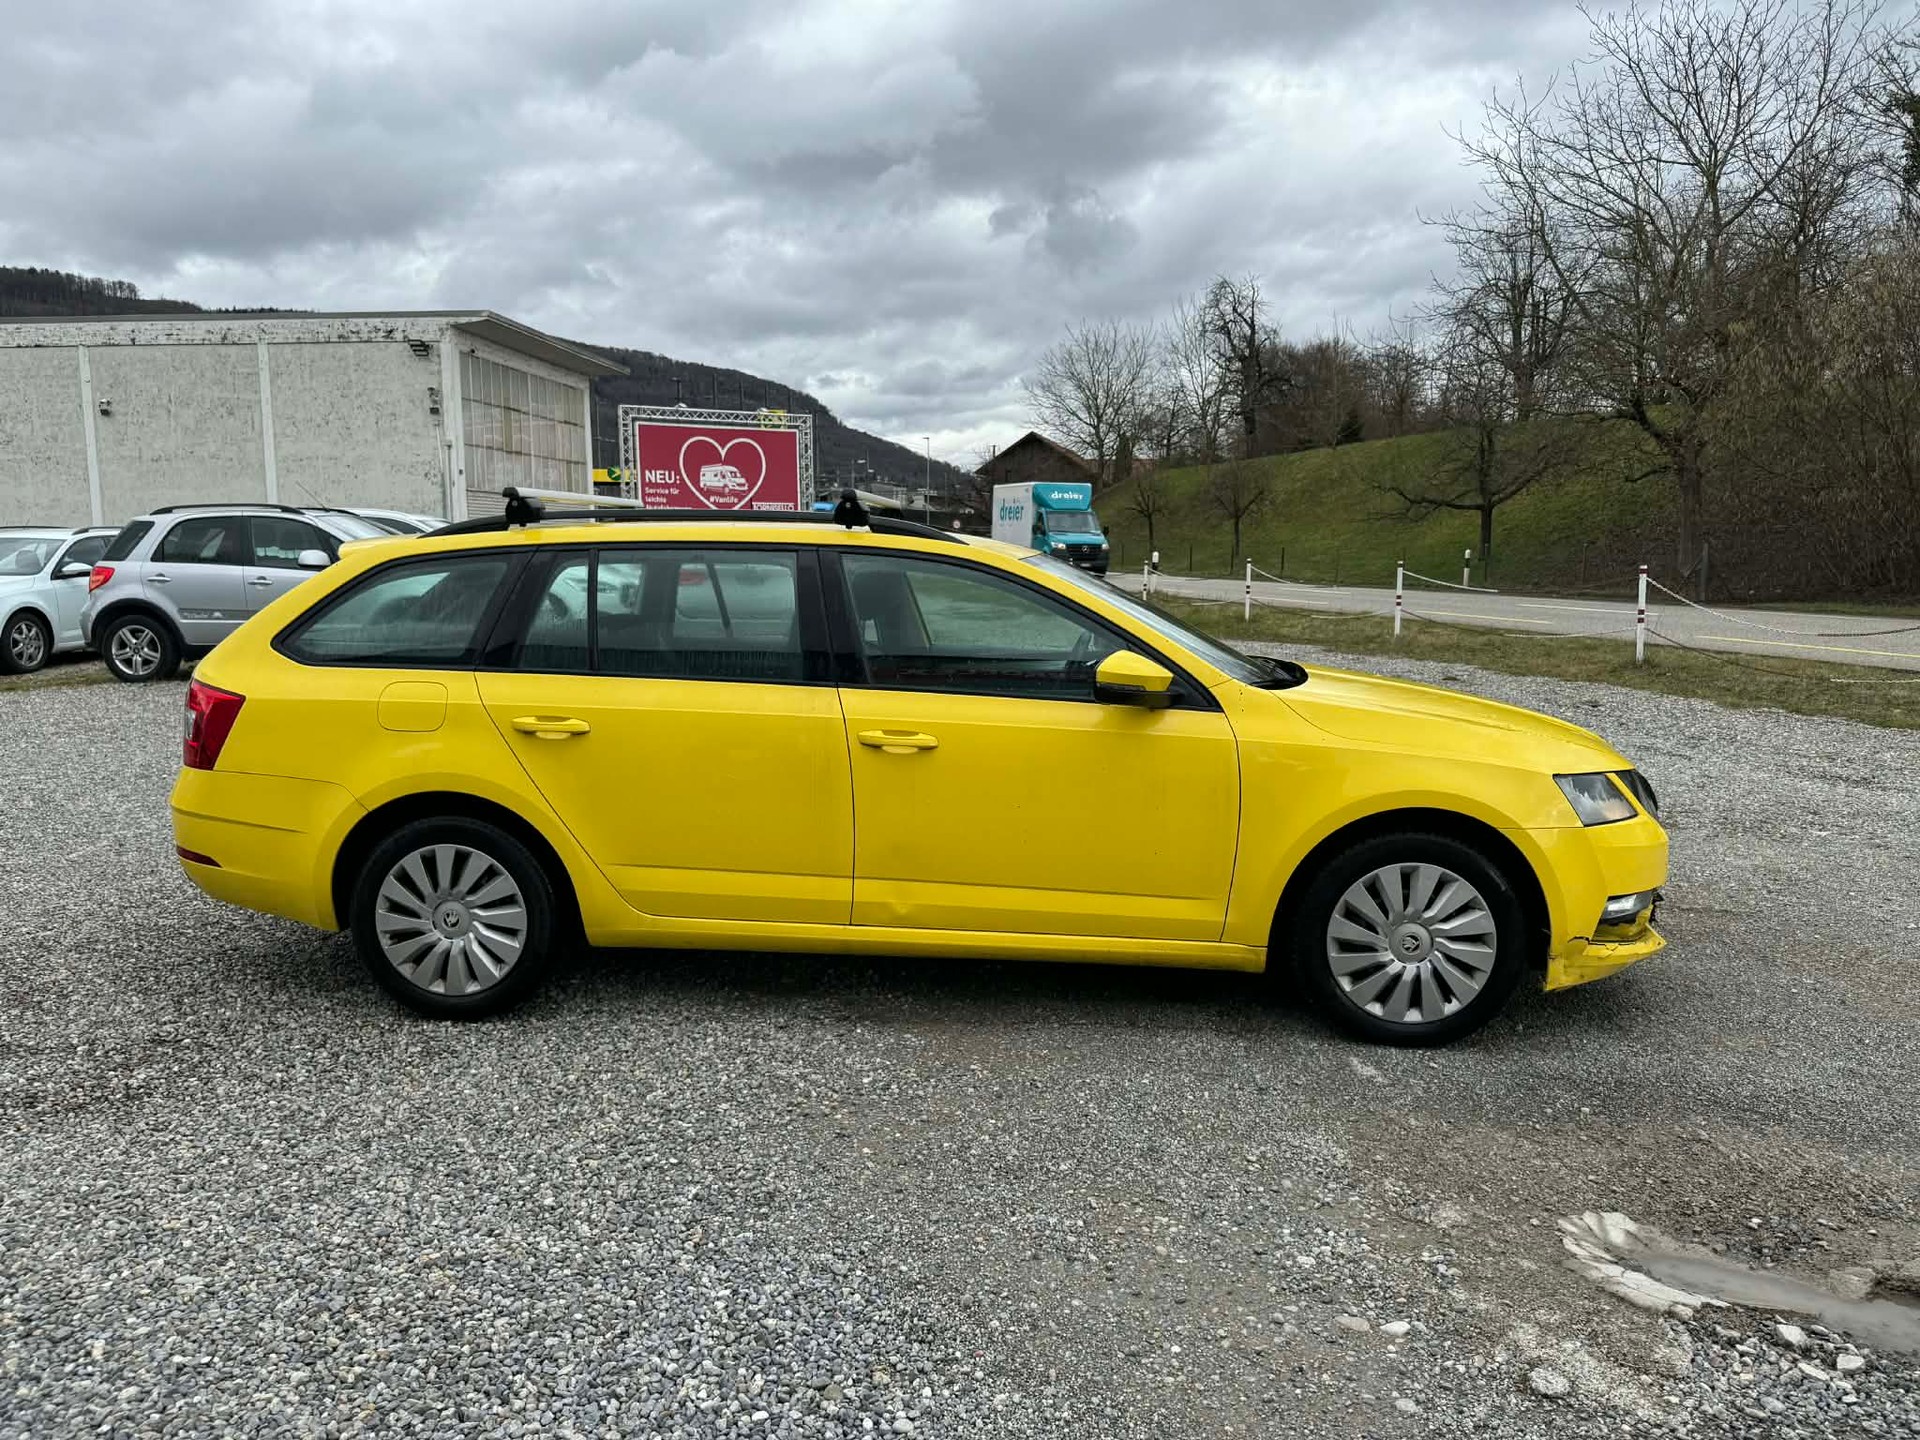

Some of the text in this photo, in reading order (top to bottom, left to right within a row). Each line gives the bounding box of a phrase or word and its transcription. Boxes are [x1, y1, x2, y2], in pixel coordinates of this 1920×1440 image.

[645, 469, 680, 484] NEU:
[645, 487, 680, 495] Service für
[1051, 491, 1083, 500] dreier
[1000, 498, 1025, 521] dreier
